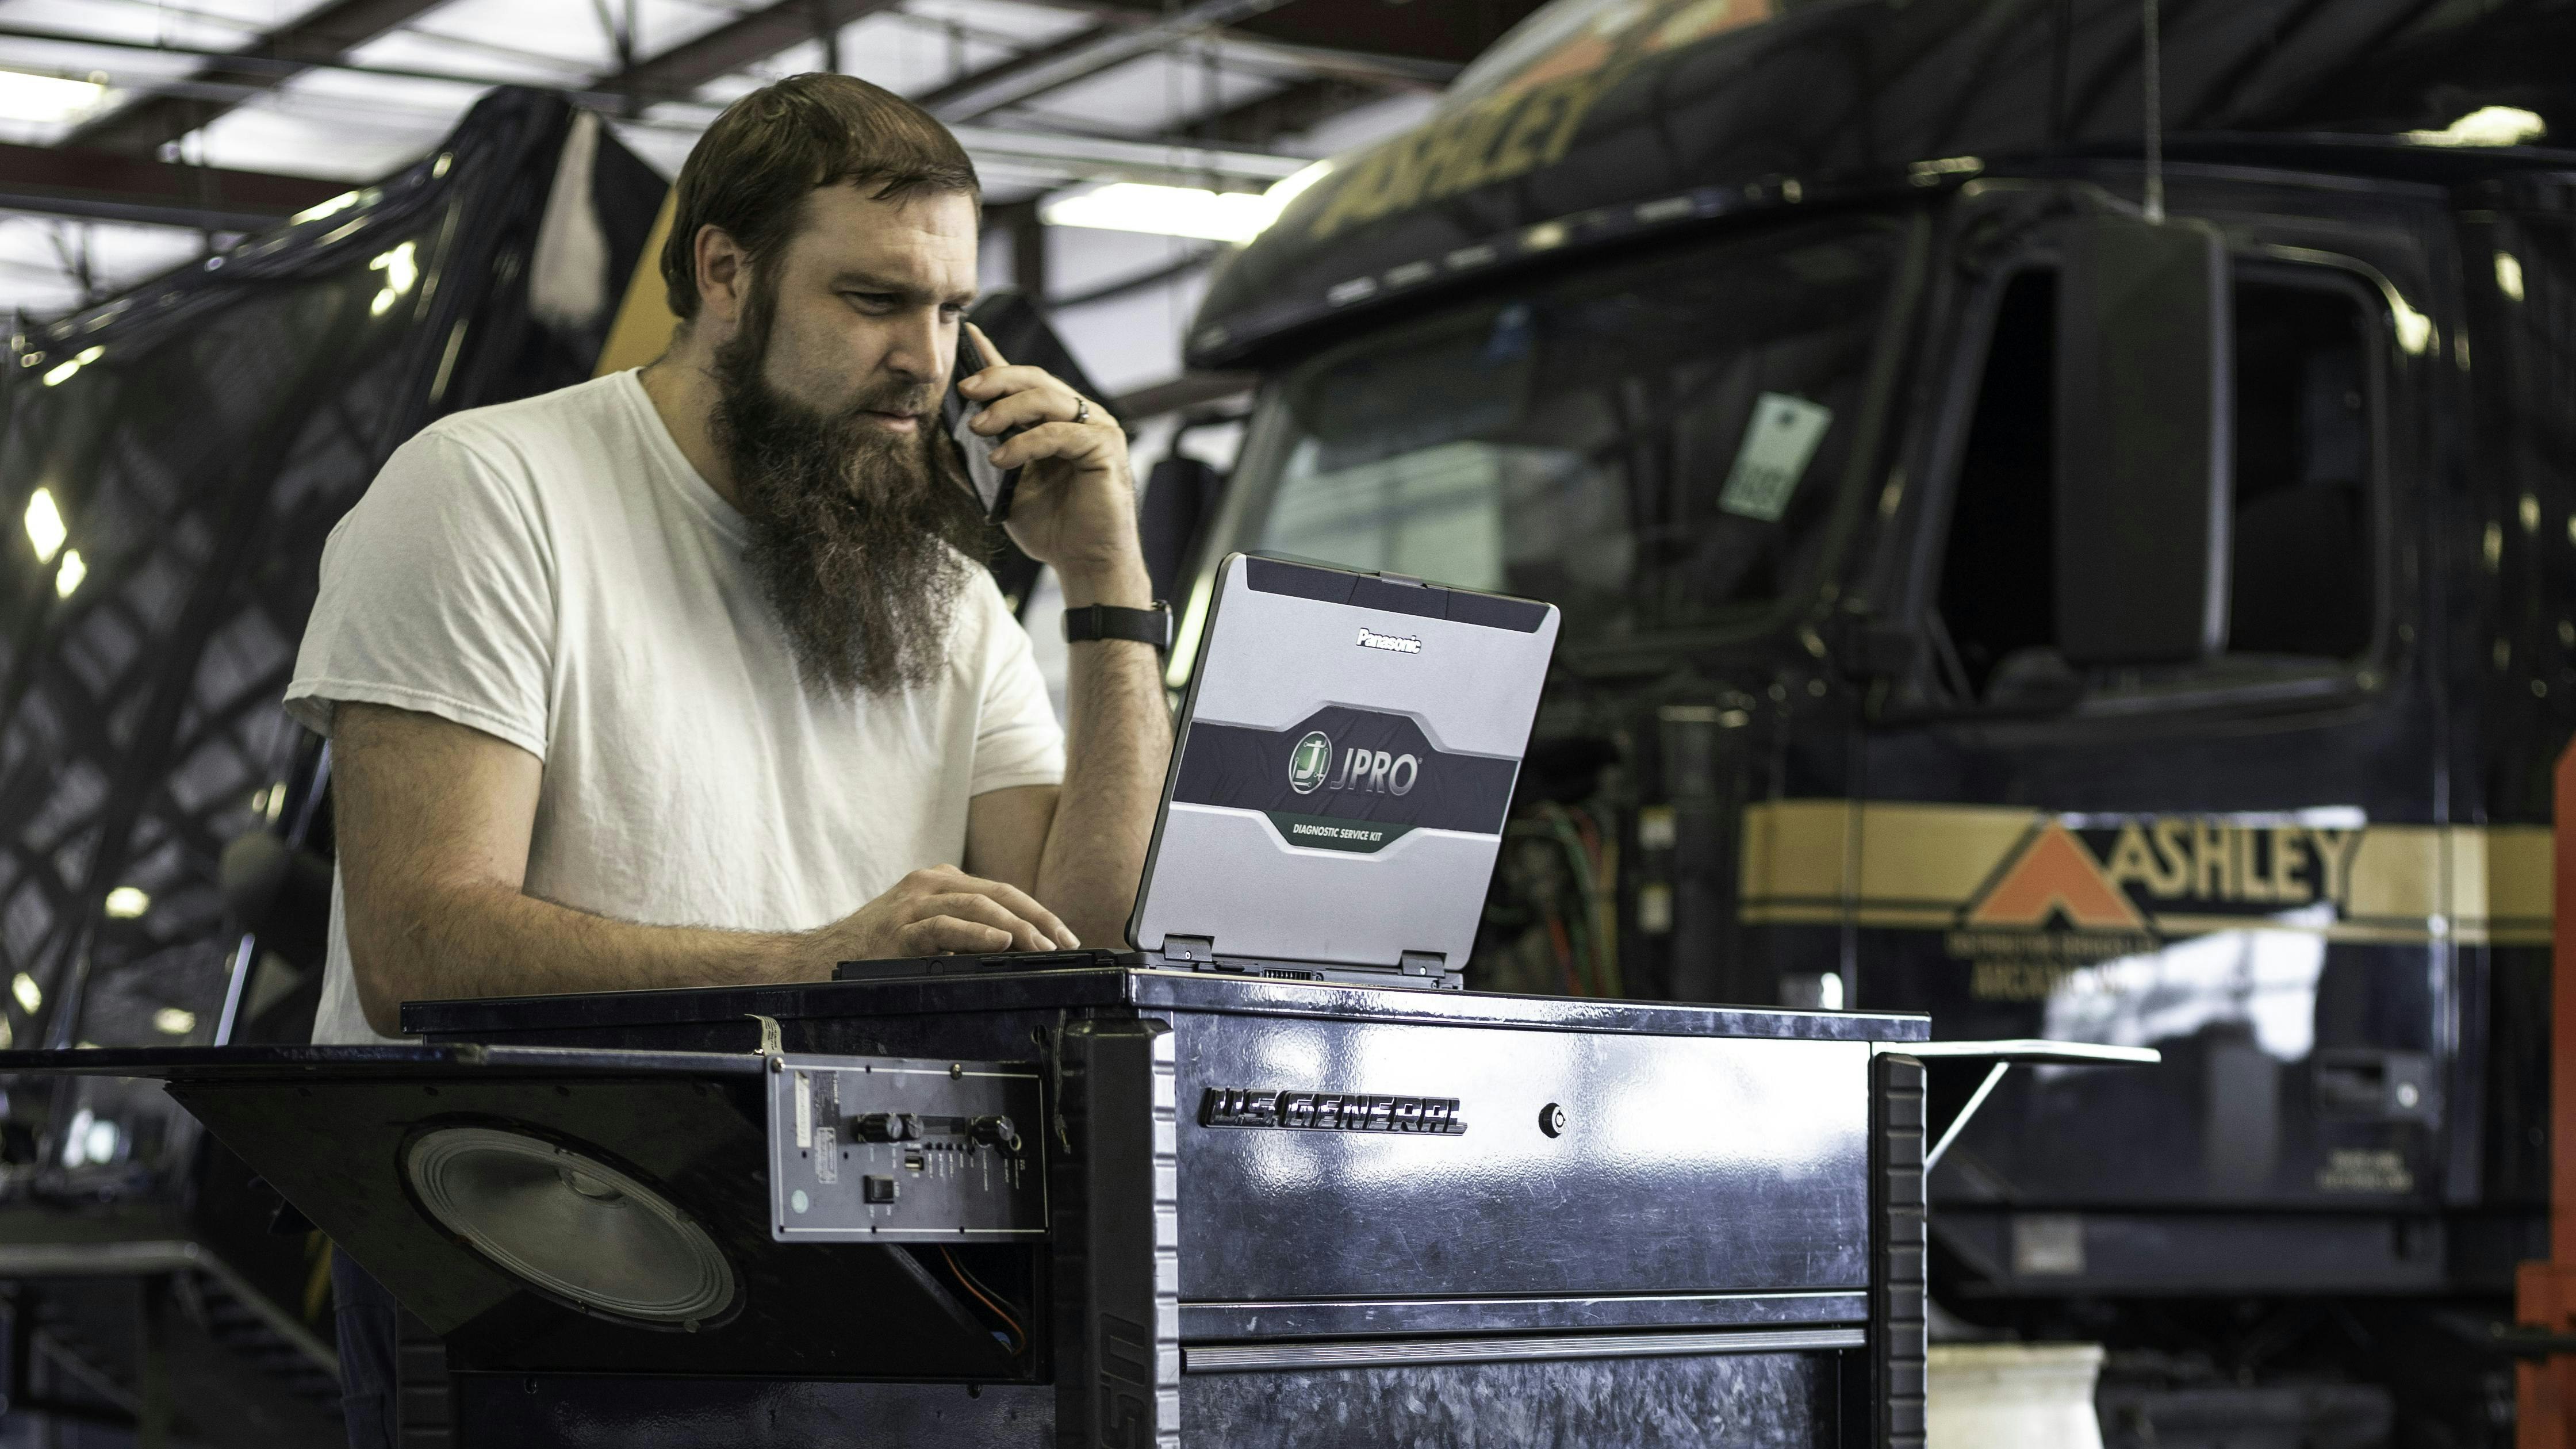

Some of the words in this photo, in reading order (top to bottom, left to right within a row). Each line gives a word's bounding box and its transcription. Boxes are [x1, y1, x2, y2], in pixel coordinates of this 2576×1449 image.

[1356, 627, 1421, 654] Panasonic
[1293, 823, 1339, 838] DIAGNOSTIC
[1340, 829, 1369, 841] SERVICE
[1369, 831, 1383, 842] KIT
[2106, 819, 2352, 900] ASHLEY
[1279, 1090, 1467, 1136] GENERAL
